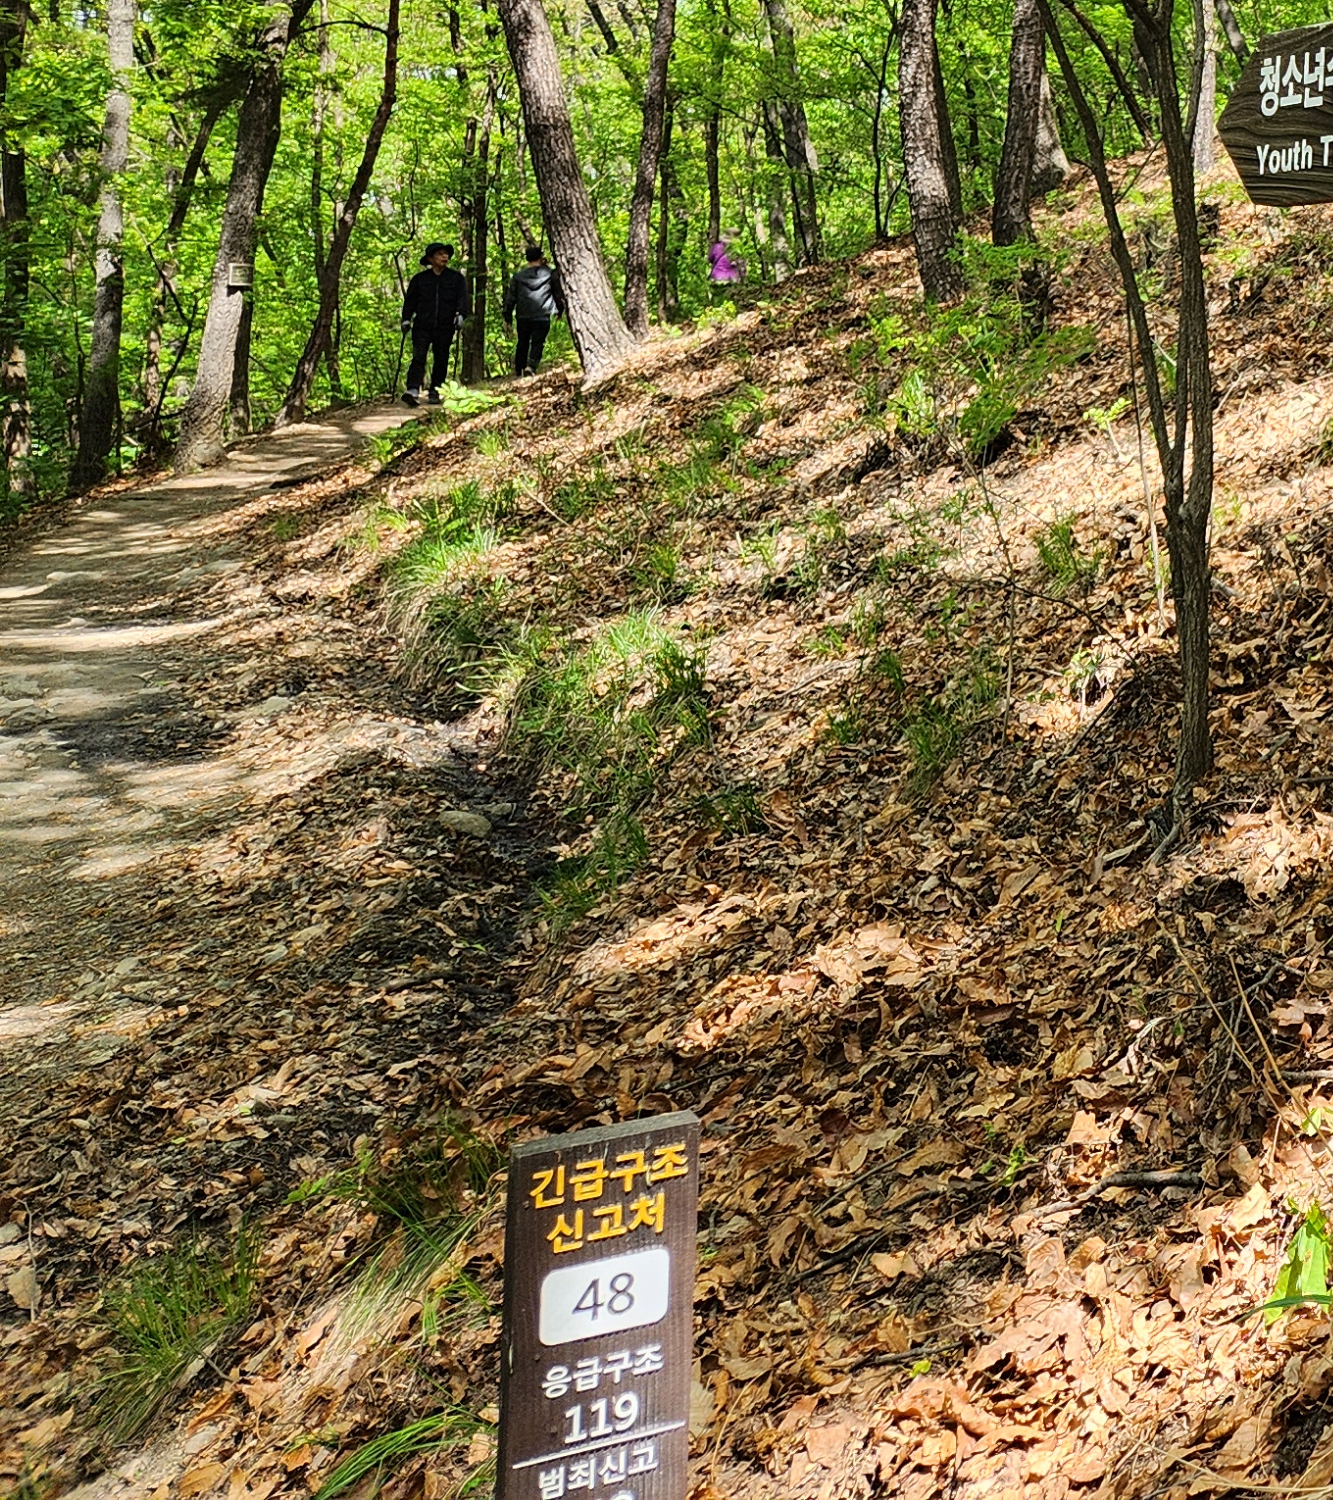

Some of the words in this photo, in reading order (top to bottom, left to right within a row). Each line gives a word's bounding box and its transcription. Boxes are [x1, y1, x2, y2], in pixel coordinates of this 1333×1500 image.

[1256, 138, 1313, 175] Youth
[529, 1143, 689, 1208] 긴급구조
[546, 1192, 667, 1254] 신고처
[571, 1272, 636, 1323] 48
[541, 1343, 665, 1400] 응급구조
[563, 1390, 641, 1445] 119
[538, 1443, 659, 1500] 범죄신고
